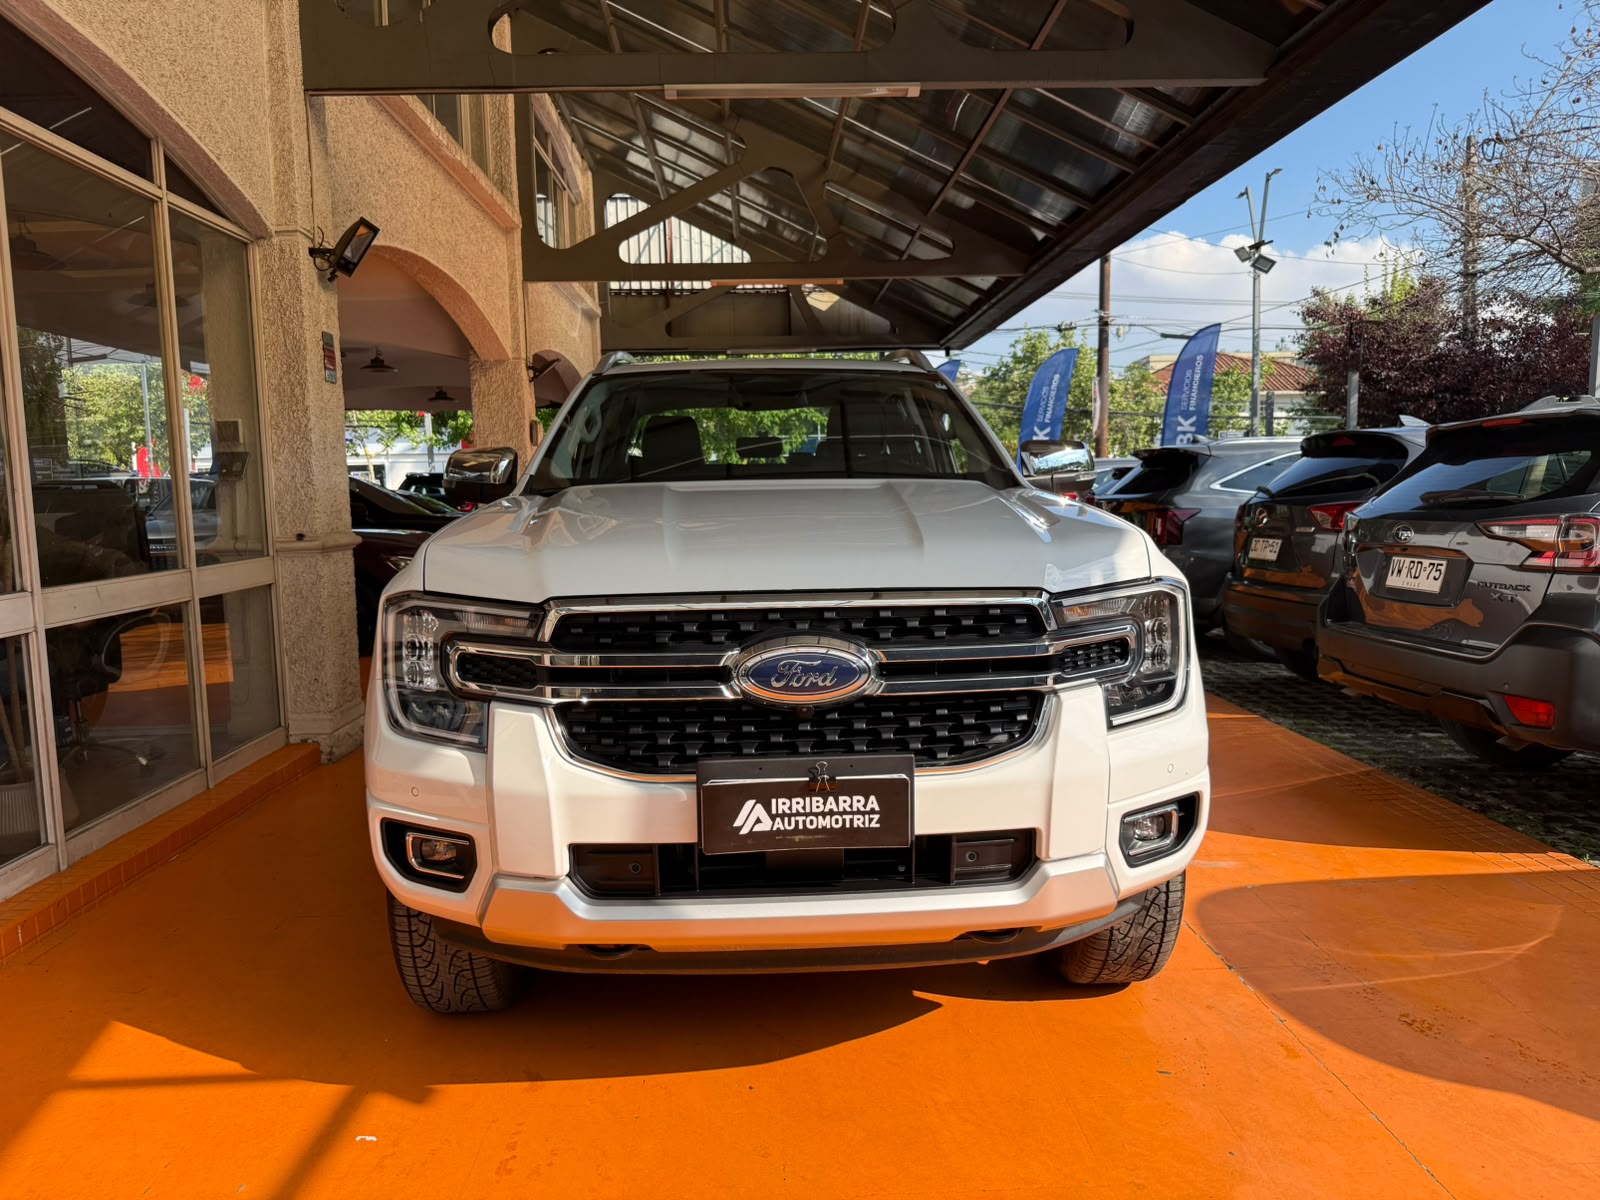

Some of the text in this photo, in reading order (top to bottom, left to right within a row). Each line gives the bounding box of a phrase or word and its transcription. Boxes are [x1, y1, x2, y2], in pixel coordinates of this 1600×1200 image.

[1189, 354, 1204, 411] FINANCIEROS
[1476, 581, 1531, 592] OUTBACK
[770, 659, 839, 688] Ford
[771, 795, 880, 814] IRRIBARRA
[772, 814, 881, 831] AUTOMOTRIZ
